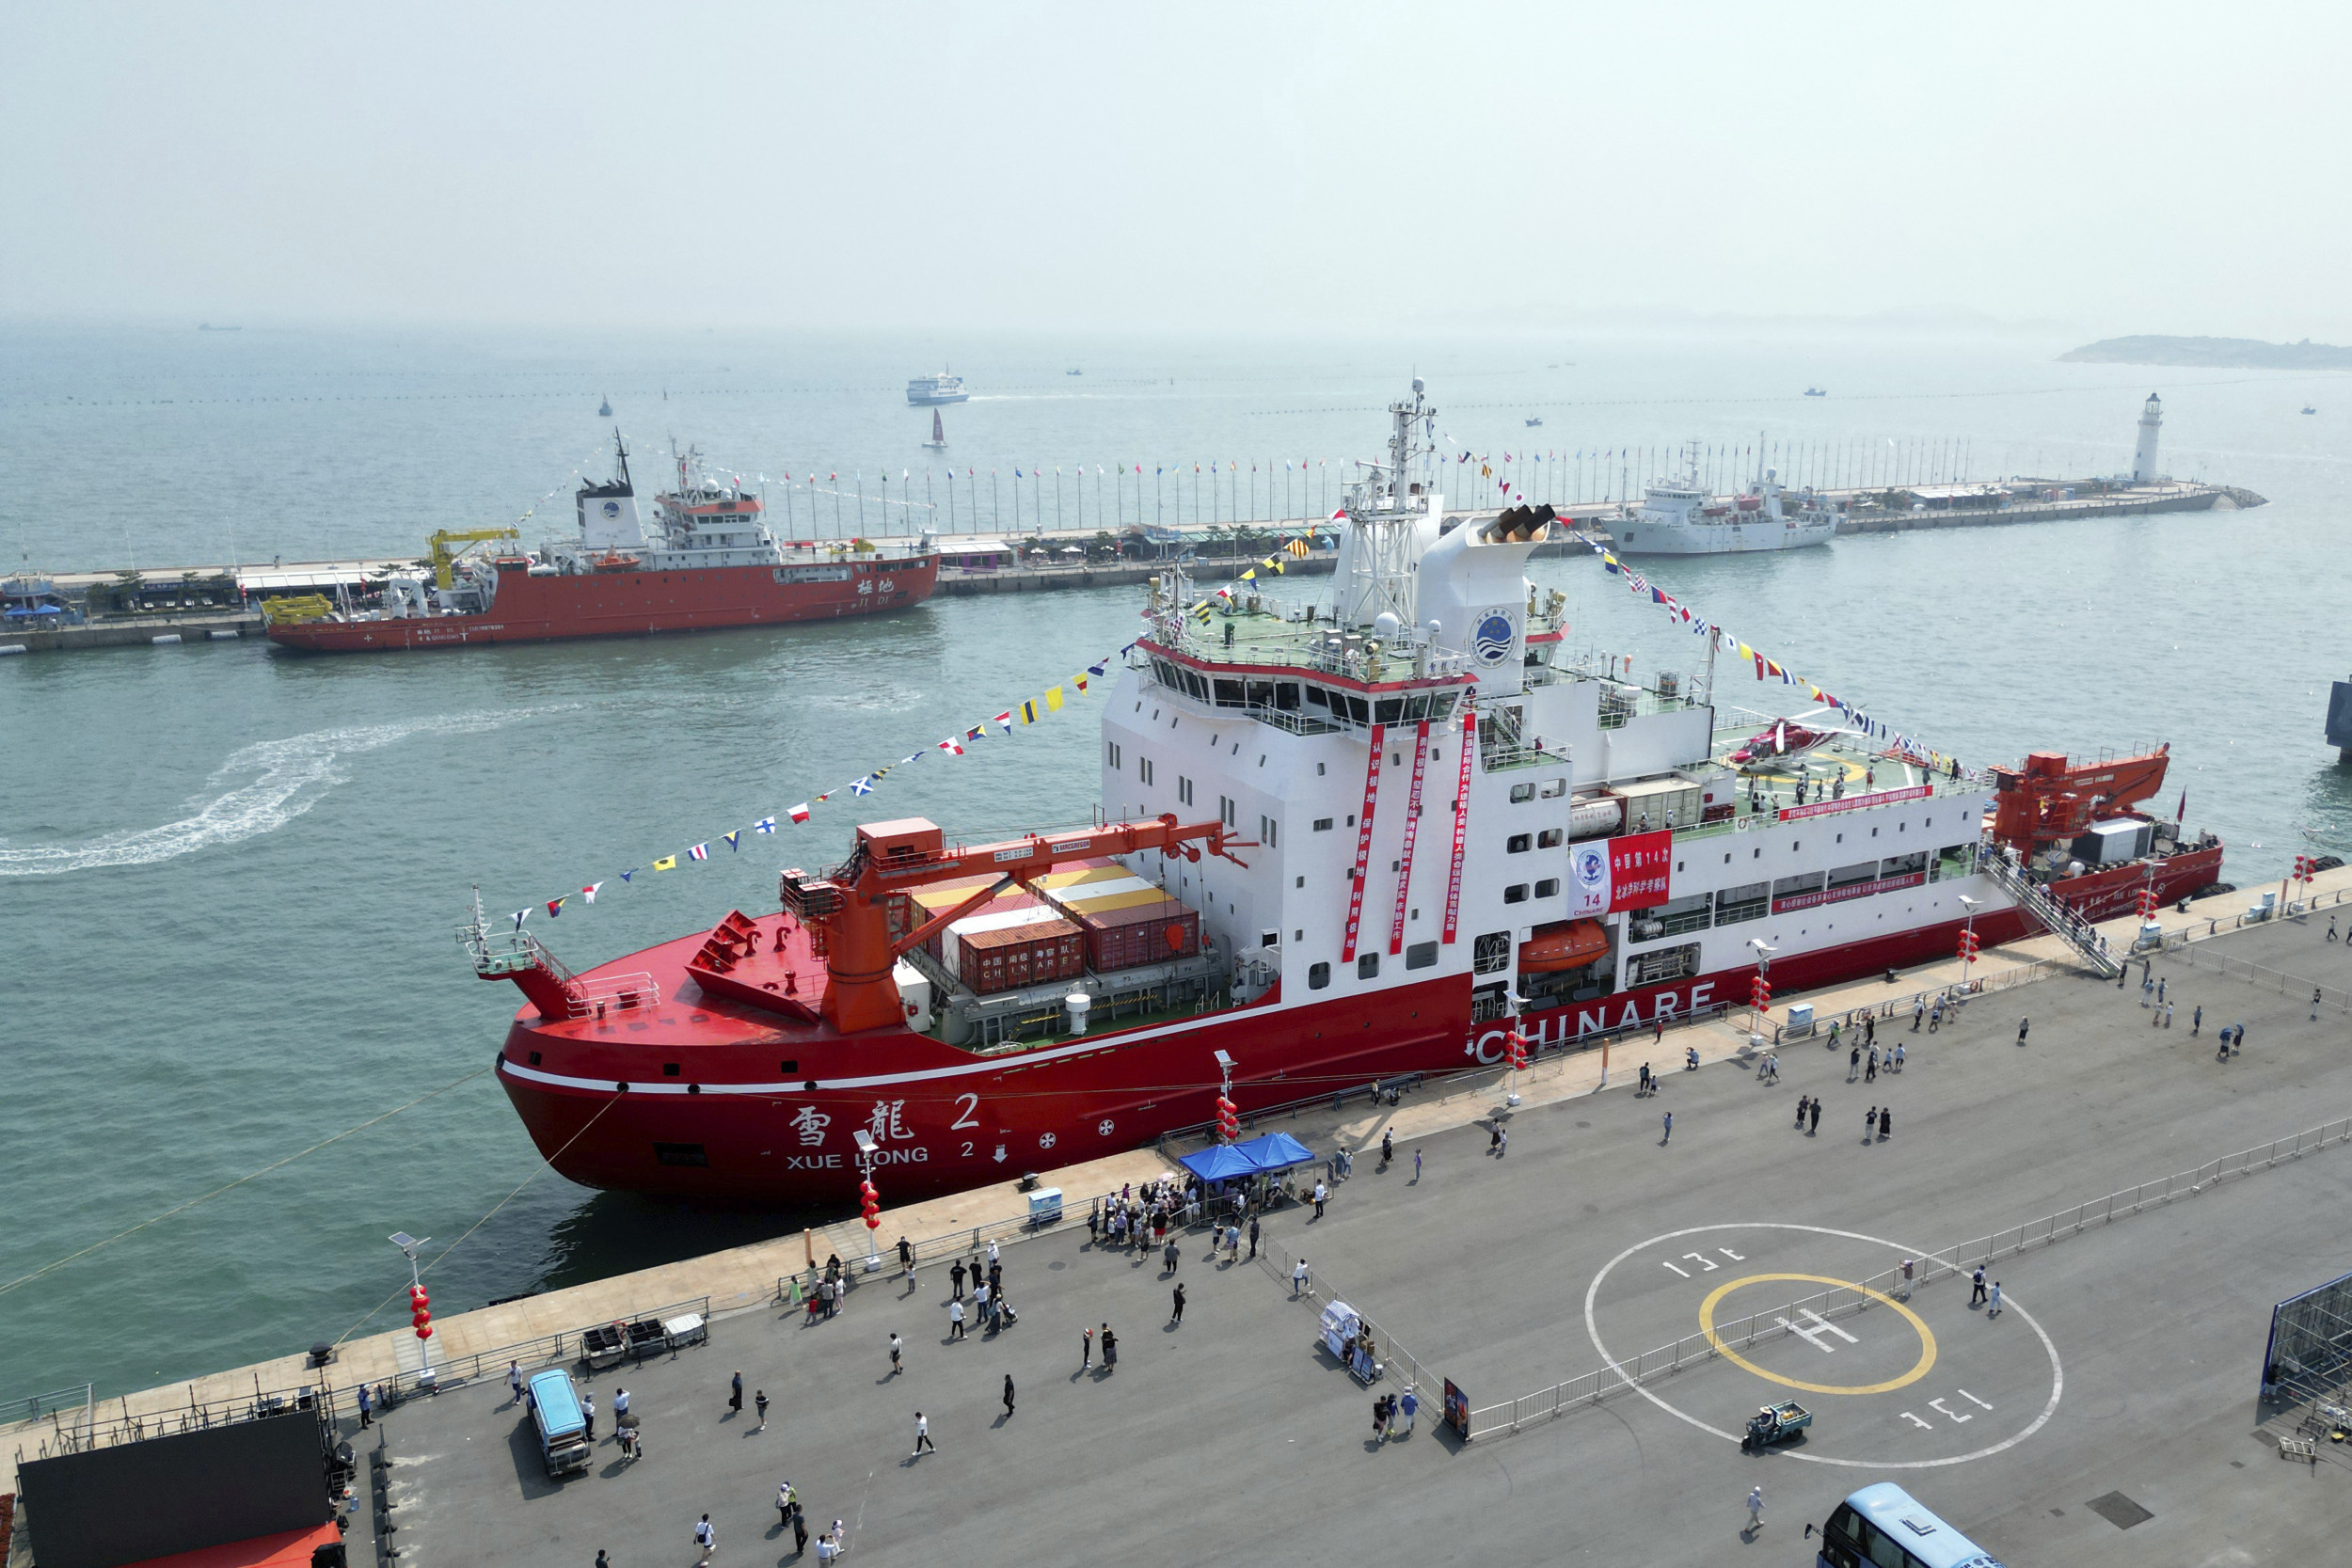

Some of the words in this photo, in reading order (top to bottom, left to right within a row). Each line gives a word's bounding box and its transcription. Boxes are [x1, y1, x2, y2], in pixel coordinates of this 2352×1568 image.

[859, 597, 868, 608] JI
[877, 595, 889, 605] DI
[1573, 907, 1604, 916] CHINARE
[1583, 894, 1601, 907] 14
[983, 956, 1068, 979] CHINARE
[1476, 980, 1715, 1065] CHINARE
[950, 1092, 979, 1131] 2
[787, 1154, 843, 1170] XUE
[854, 1147, 929, 1167] LONG
[961, 1141, 974, 1157] 2
[1773, 1307, 1859, 1354] H
